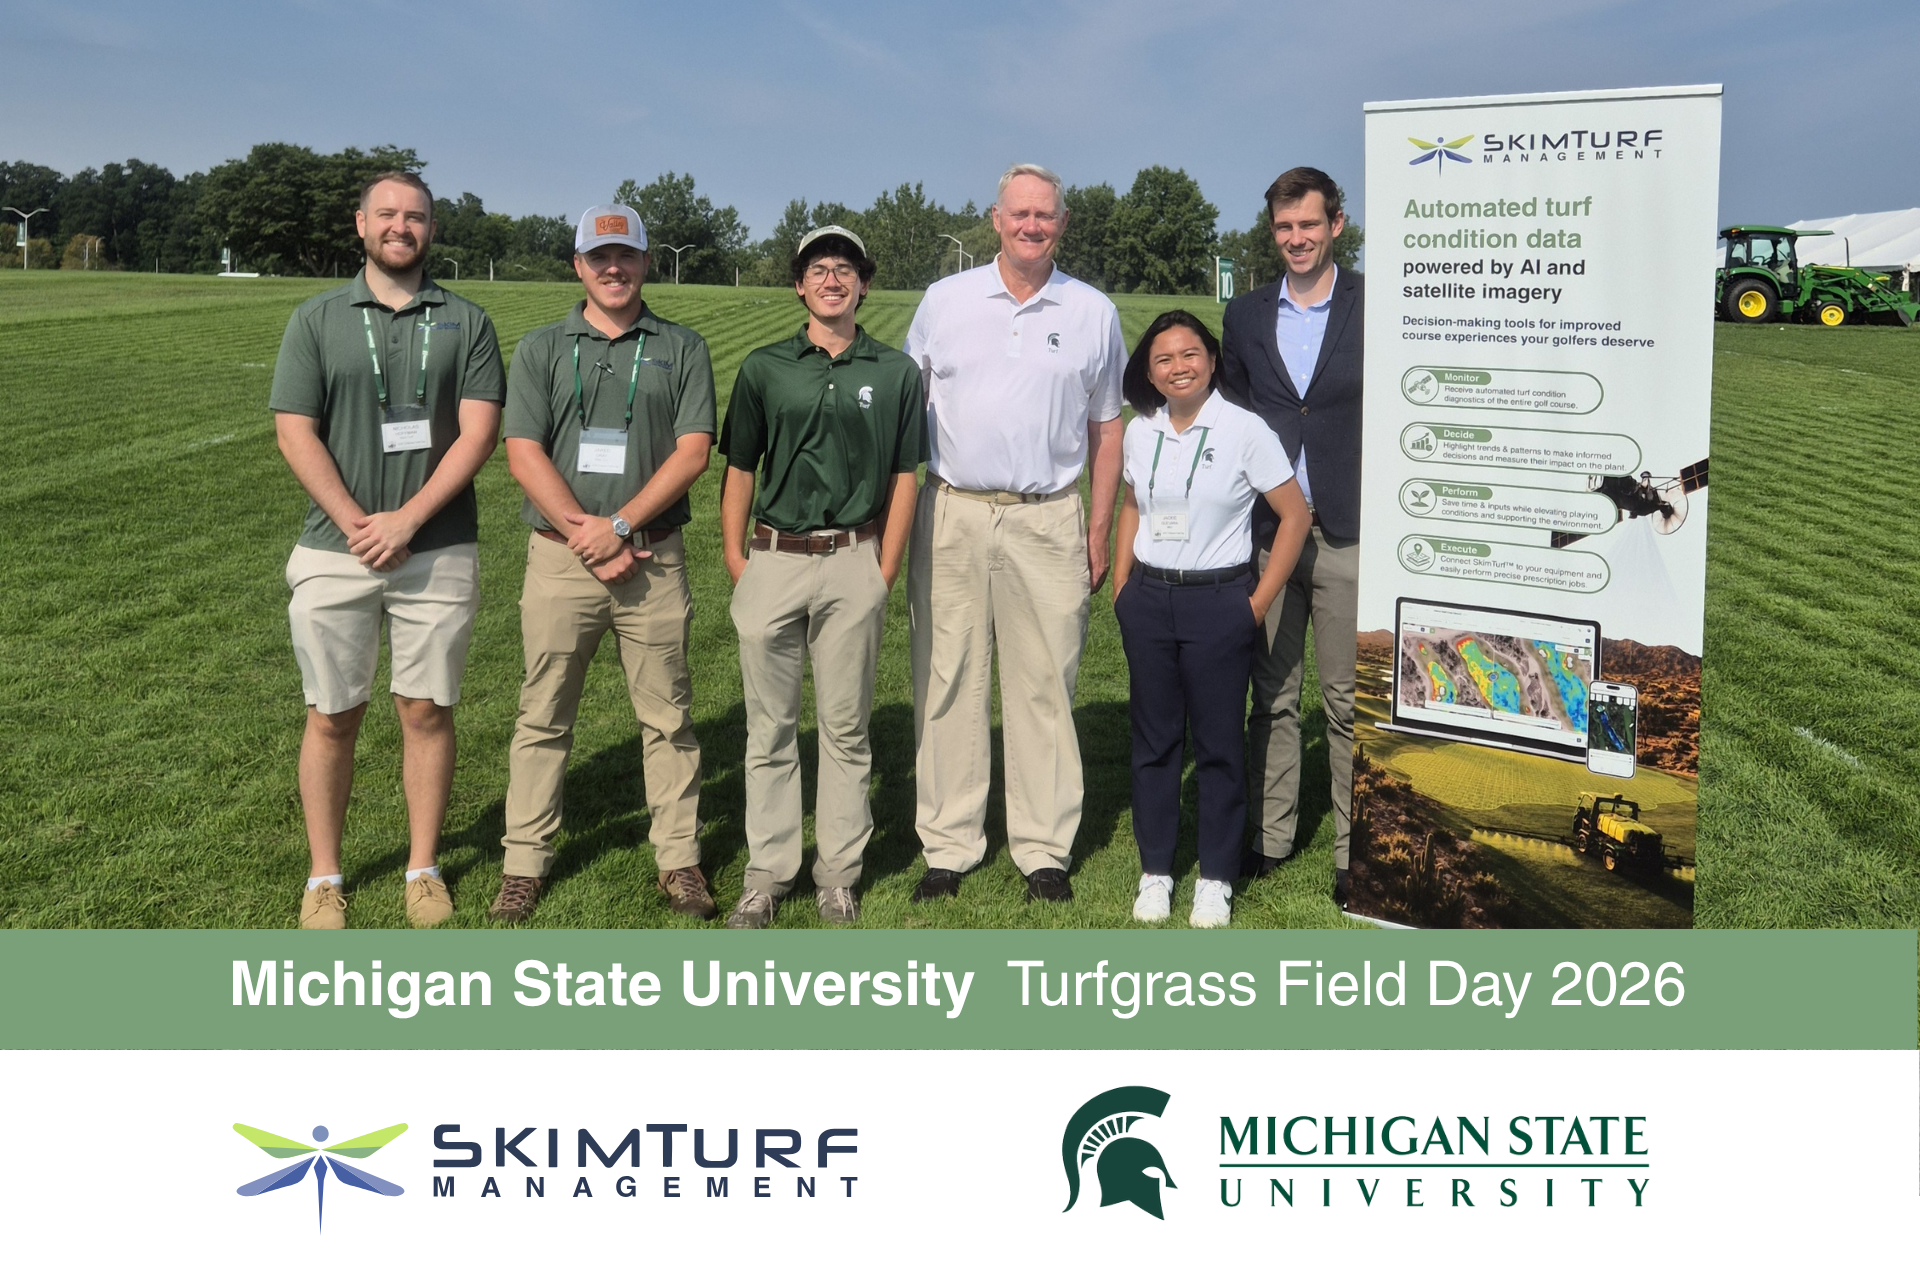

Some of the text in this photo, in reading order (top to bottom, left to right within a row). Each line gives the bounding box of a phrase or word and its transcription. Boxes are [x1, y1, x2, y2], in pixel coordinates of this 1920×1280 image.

[1483, 149, 1663, 163] MANAGEMENT
[1403, 196, 1593, 219] Automated turf
[1403, 229, 1582, 249] condition data
[1403, 259, 1586, 278] powered by AI and
[1221, 272, 1233, 299] 10
[1402, 283, 1562, 304] satellite imagery
[1402, 315, 1621, 333] Decision-making tools for improved
[1402, 331, 1655, 348] course experiences your golfers deserve
[1445, 373, 1480, 382] Monitor
[1445, 386, 1473, 394] Receive
[1476, 387, 1515, 396] automated
[1532, 389, 1566, 398] condition
[1444, 395, 1485, 405] diagnostics
[1497, 397, 1509, 405] the
[1534, 400, 1548, 408] golf
[1444, 430, 1475, 439] Decide
[1443, 442, 1474, 452] Highlight
[1476, 444, 1501, 452] trends
[1510, 446, 1541, 455] patterns
[1553, 449, 1573, 458] make
[1576, 451, 1611, 460] informed
[1443, 451, 1476, 460] decisions
[1479, 453, 1494, 461] and
[1496, 455, 1528, 464] measure
[1530, 457, 1547, 465] their
[1550, 458, 1574, 468] impact
[1589, 461, 1602, 470] the
[1605, 462, 1627, 472] plant.
[1442, 487, 1478, 497] Perform
[1442, 499, 1459, 508] Save
[1462, 500, 1478, 508] time
[1488, 502, 1510, 512] inputs
[1513, 504, 1532, 514] while
[1534, 506, 1567, 518] elevating
[1569, 509, 1598, 520] playing
[1441, 508, 1603, 530] conditions and supporting the environment.
[1441, 543, 1477, 554] Execute
[1440, 555, 1471, 565] Connect
[1525, 565, 1542, 573] your
[1544, 566, 1584, 578] equipment
[1587, 570, 1602, 579] and
[1440, 564, 1587, 588] easily perform precise prescription jobs.
